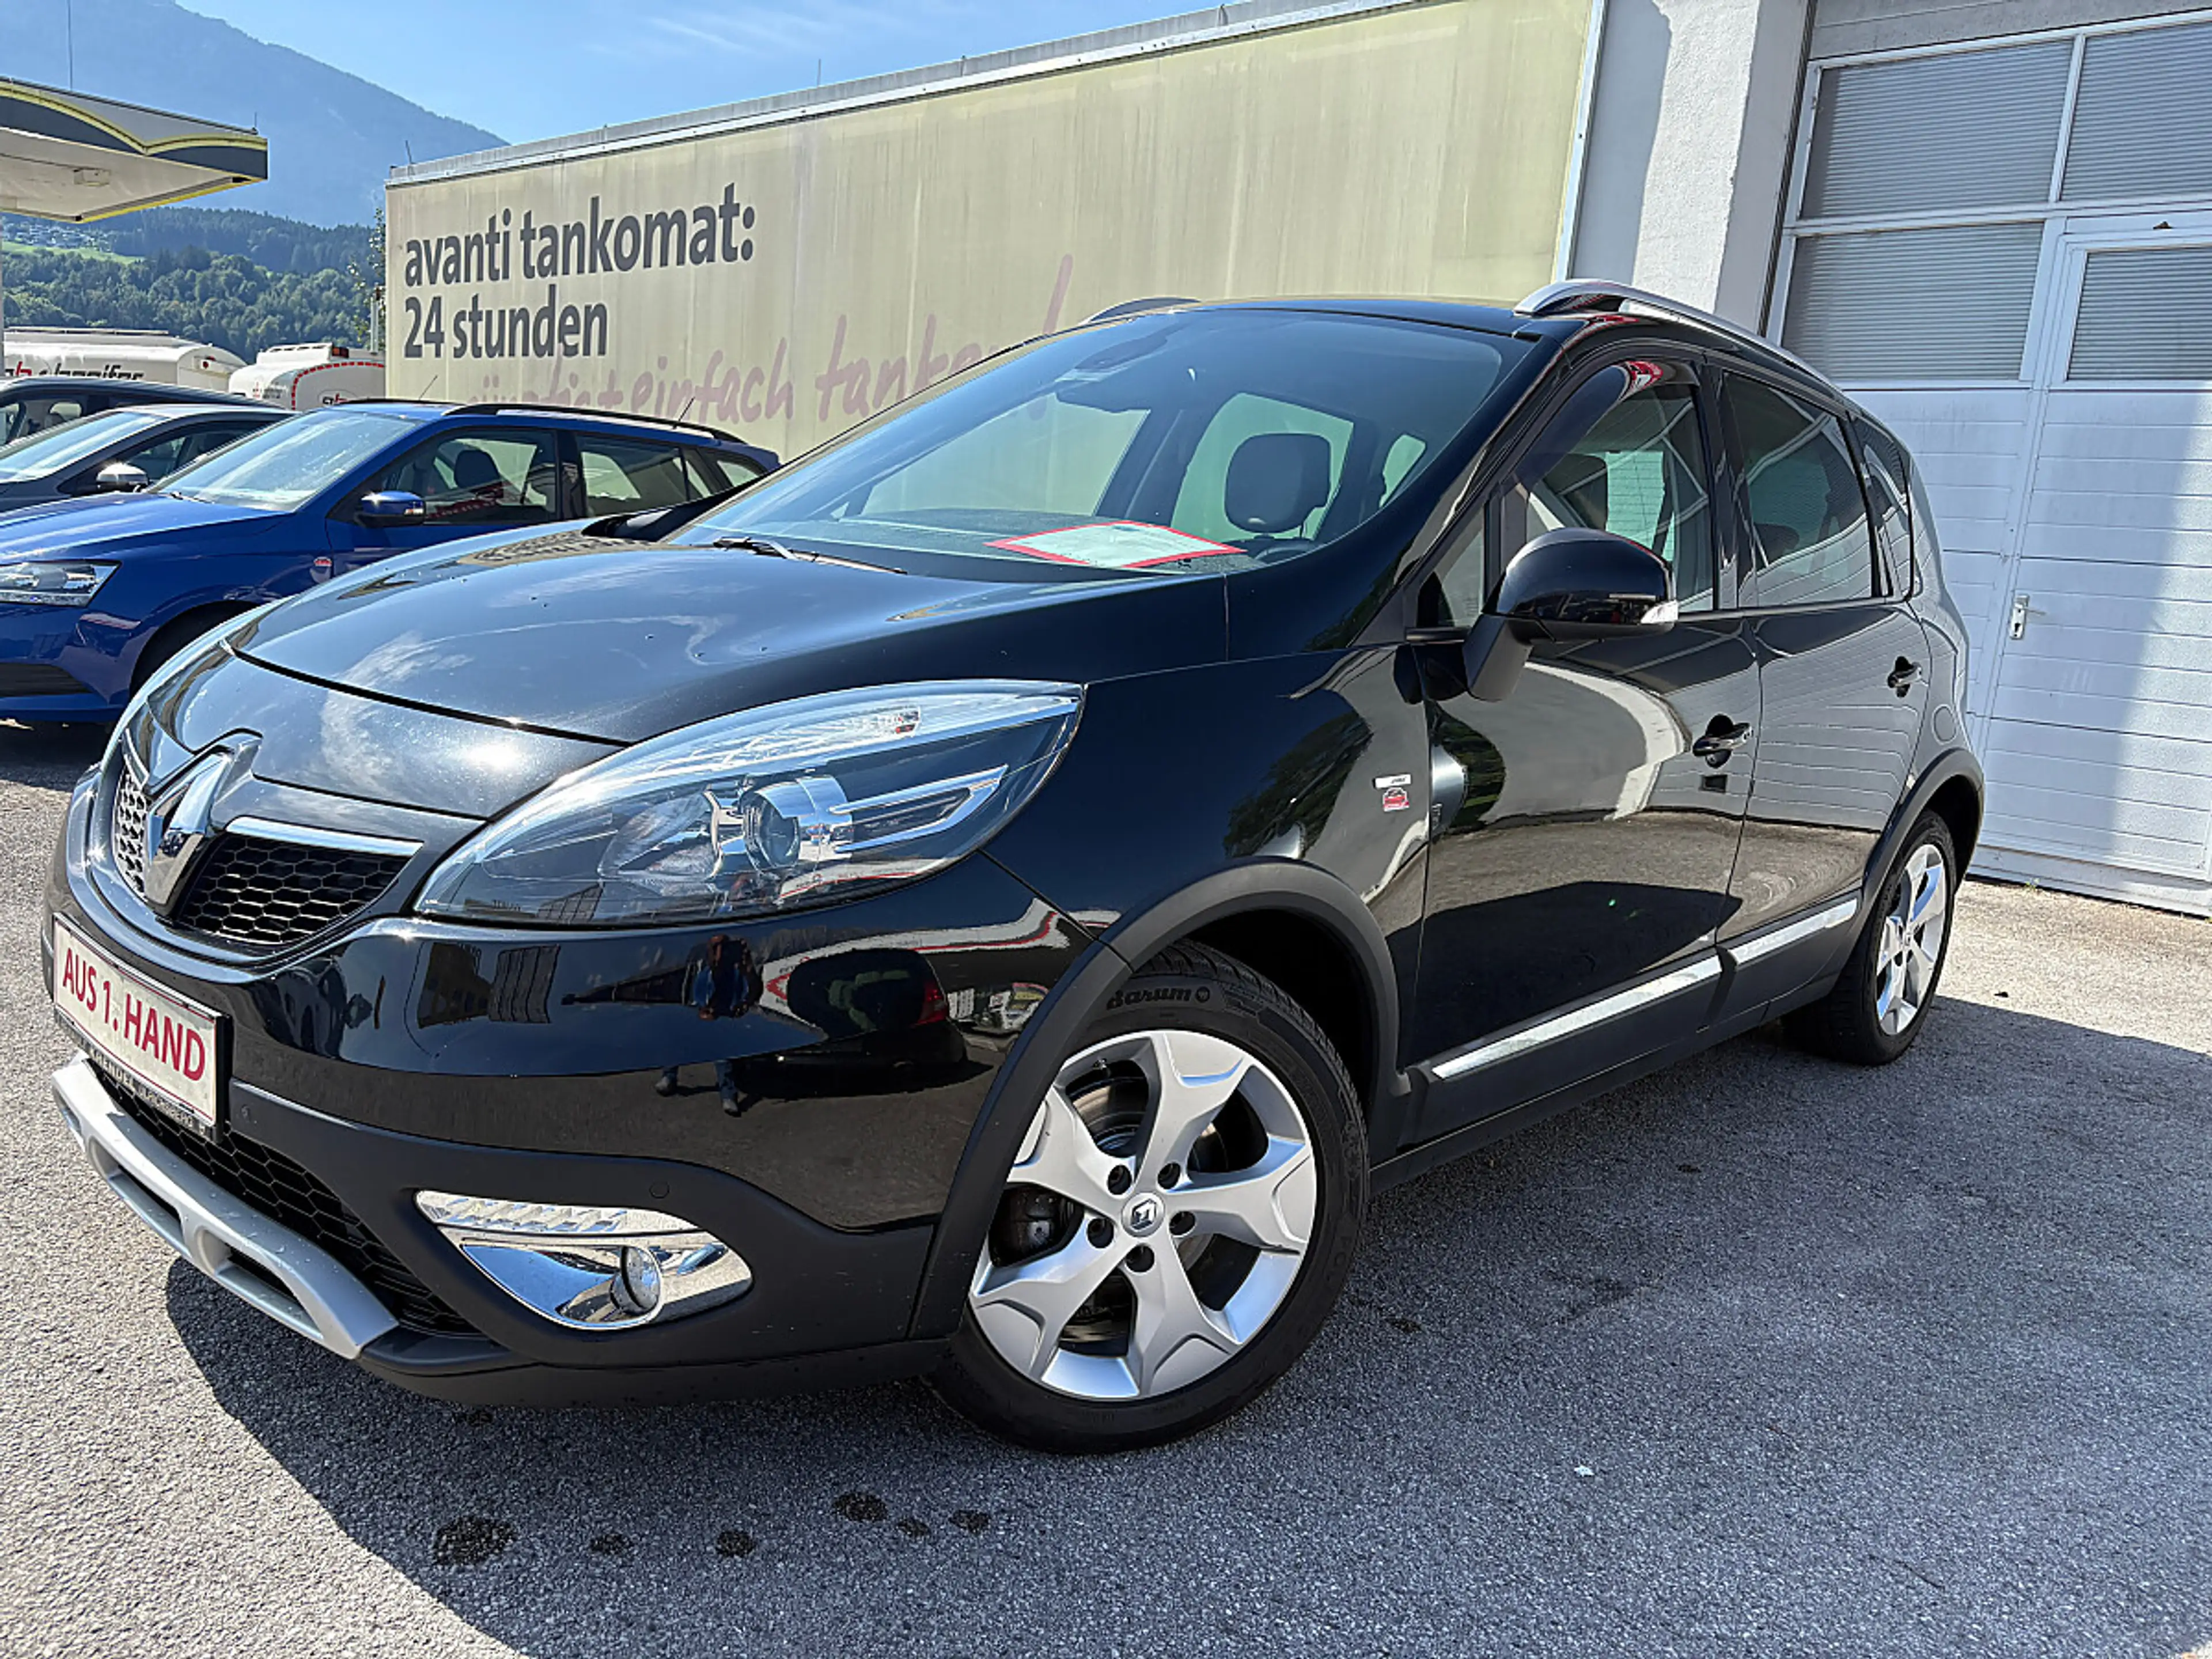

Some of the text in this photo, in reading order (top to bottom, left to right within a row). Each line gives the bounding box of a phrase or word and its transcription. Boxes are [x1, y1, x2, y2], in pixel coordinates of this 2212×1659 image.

[404, 183, 755, 287] avanti tankomat:
[404, 284, 608, 358] 24 stunden
[630, 338, 794, 423] einfach
[63, 948, 97, 1012] AUS
[103, 980, 118, 1032] 1.
[124, 994, 205, 1081] HAND
